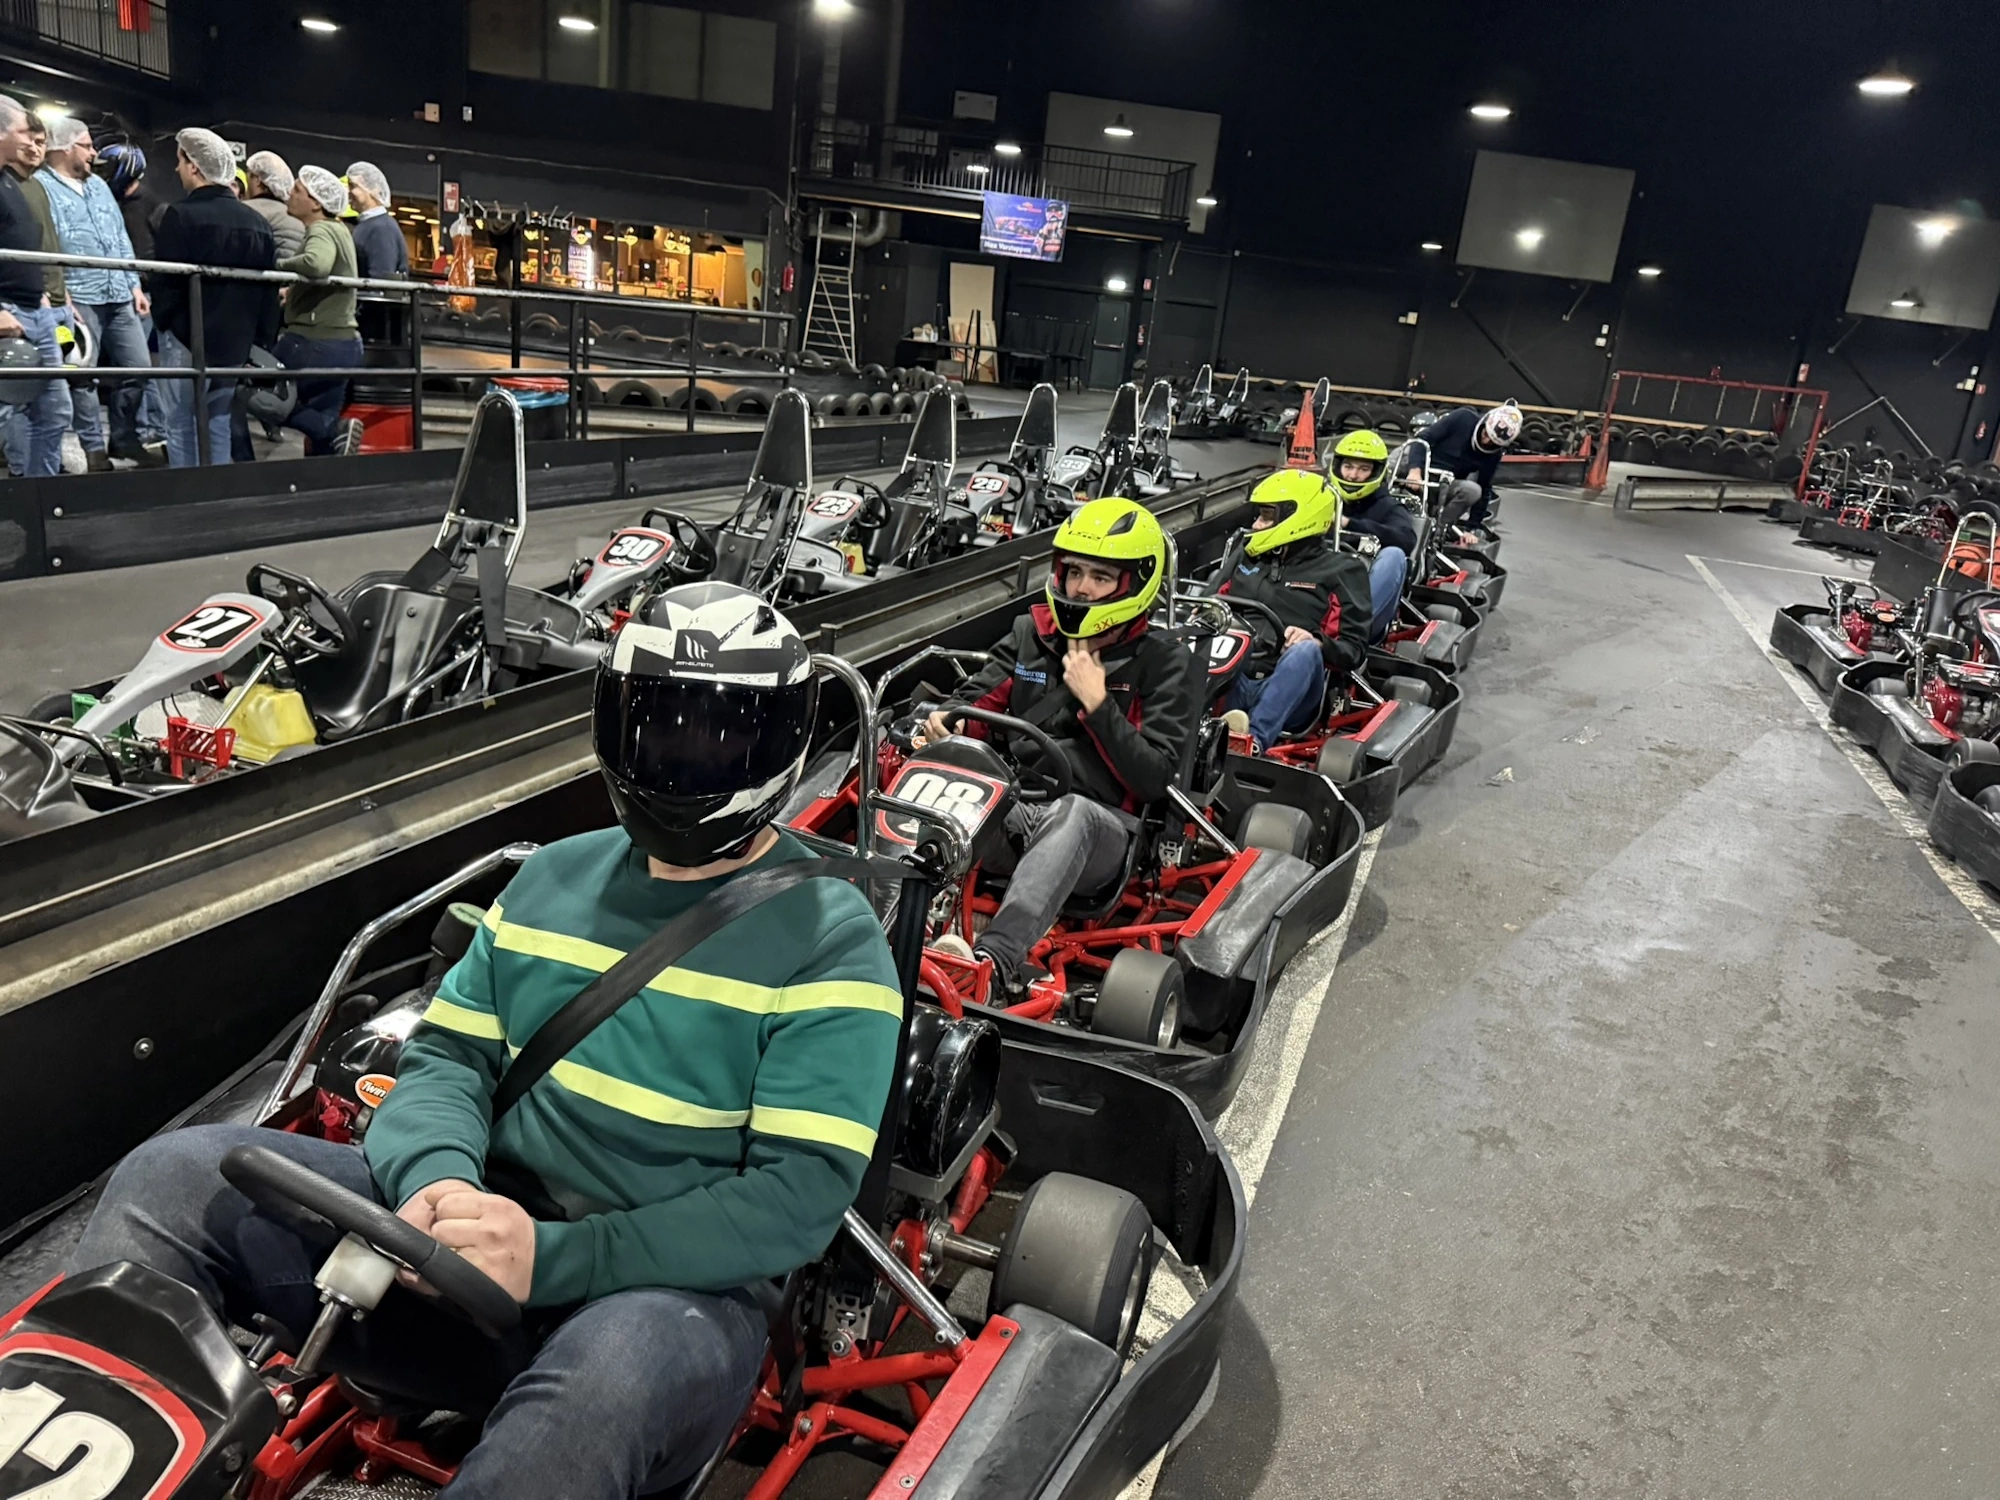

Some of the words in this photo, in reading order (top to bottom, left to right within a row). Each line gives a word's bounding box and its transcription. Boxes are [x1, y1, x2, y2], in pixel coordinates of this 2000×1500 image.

[609, 535, 660, 560] 30
[174, 607, 253, 640] 27
[1093, 617, 1119, 633] 3XL
[897, 773, 985, 814] 08
[0, 1381, 134, 1500] 12
